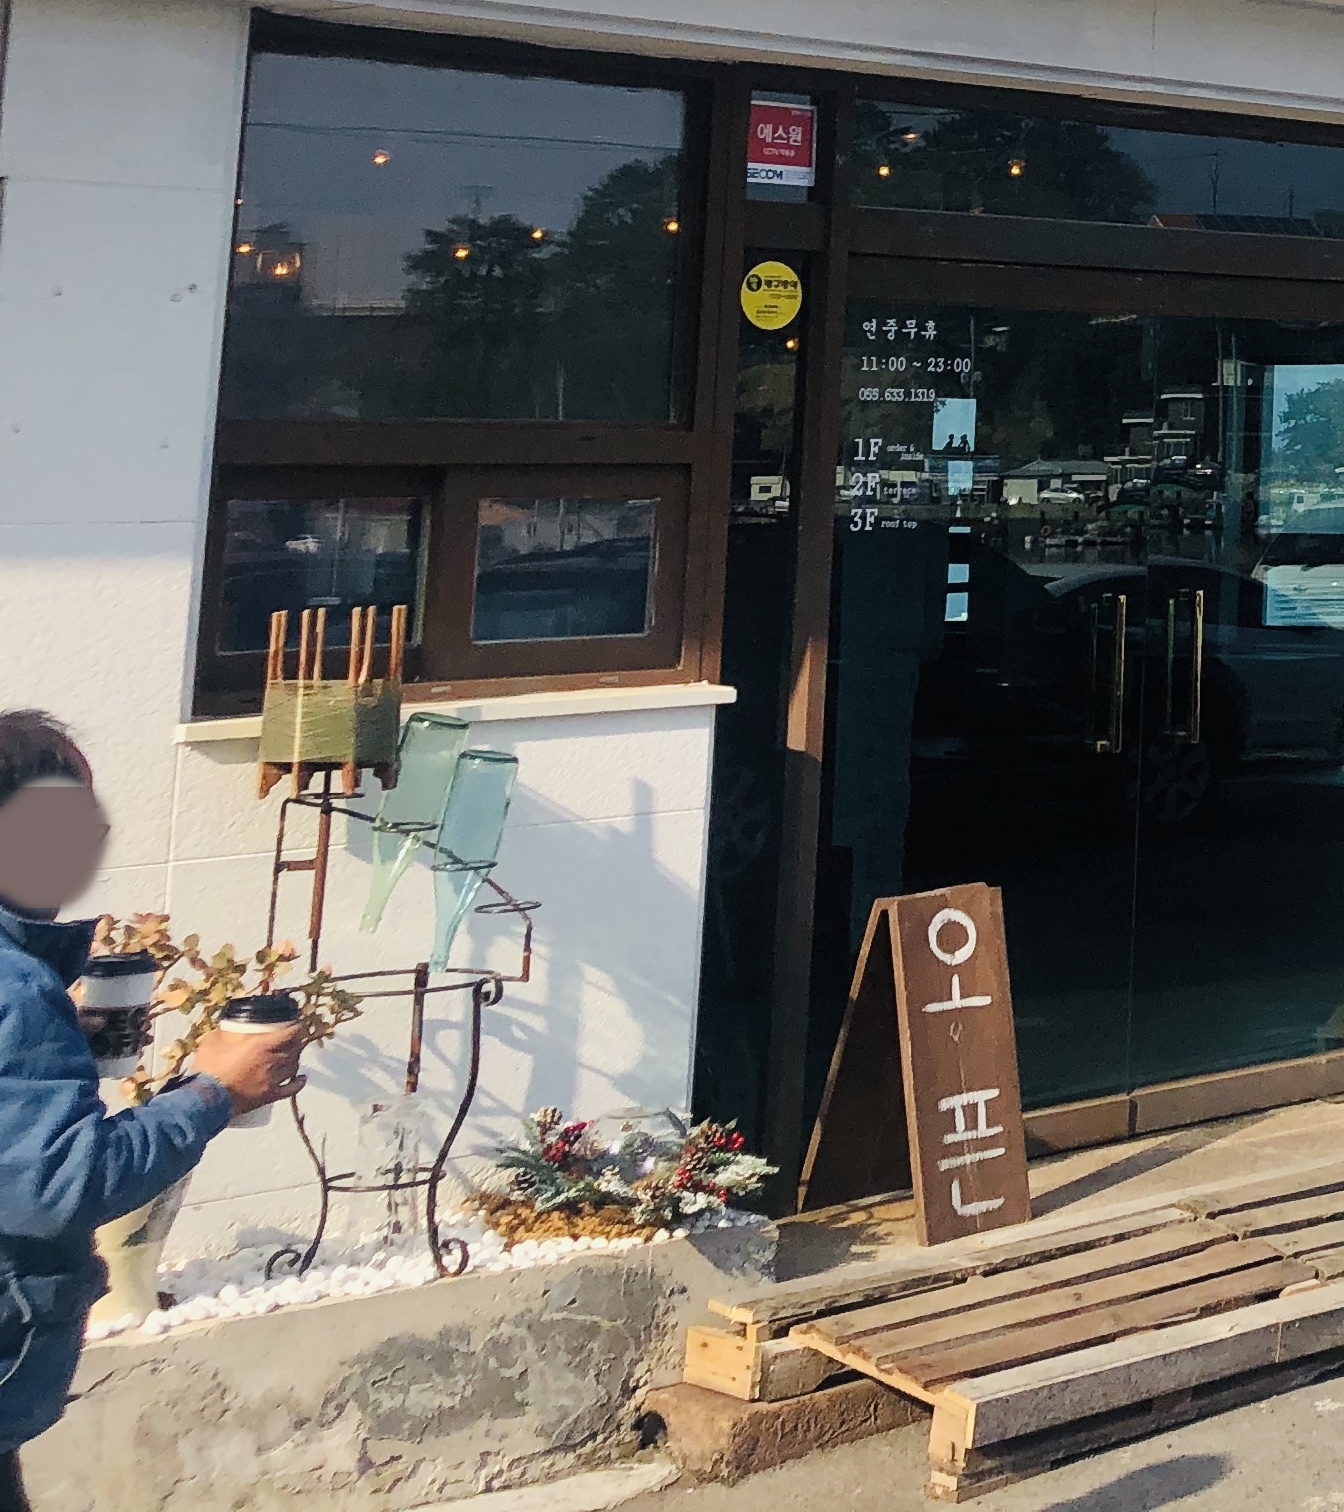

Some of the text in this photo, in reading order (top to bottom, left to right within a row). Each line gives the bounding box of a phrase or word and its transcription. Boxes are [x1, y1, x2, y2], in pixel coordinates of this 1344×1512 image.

[757, 124, 802, 146] 에스원
[862, 318, 938, 340] 연중무휴
[860, 356, 906, 371] 11:00
[927, 357, 971, 373] 23:00
[858, 387, 936, 402] 055.633.1319
[853, 438, 883, 461] 1F
[850, 472, 880, 497] 2F
[849, 508, 879, 532] 3F
[902, 521, 918, 530] top
[921, 906, 1006, 1218] 오픈
